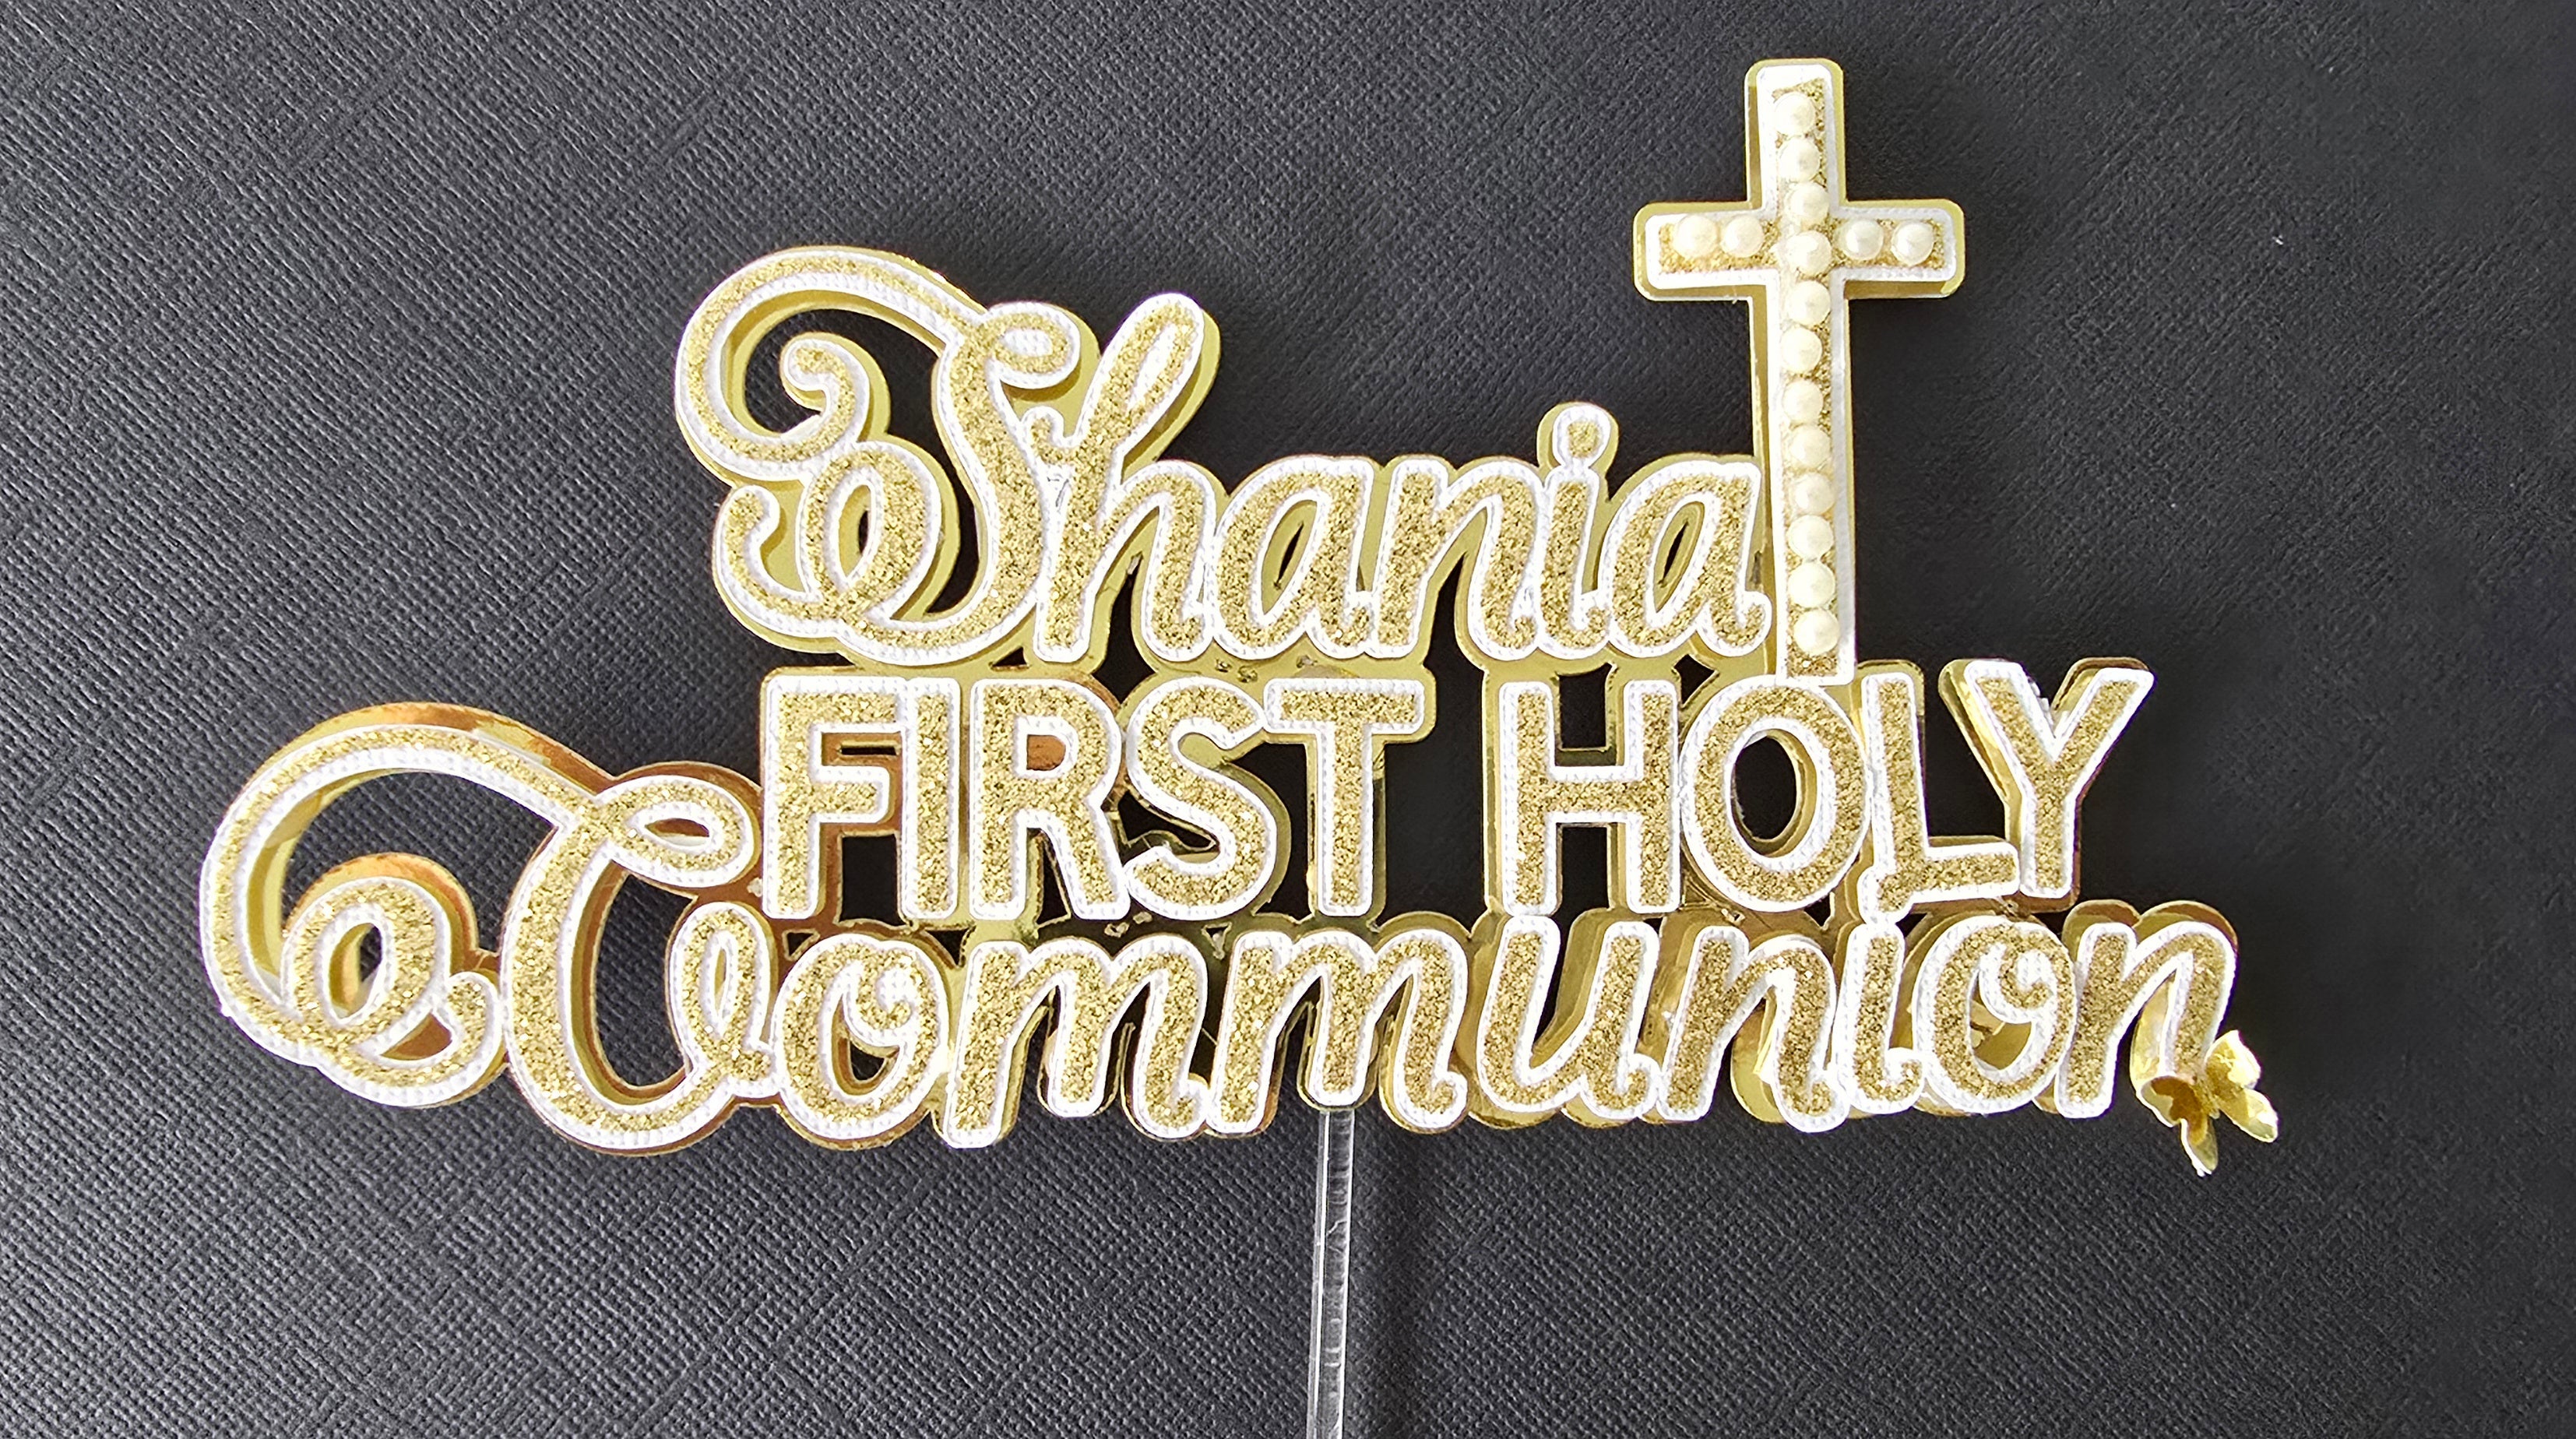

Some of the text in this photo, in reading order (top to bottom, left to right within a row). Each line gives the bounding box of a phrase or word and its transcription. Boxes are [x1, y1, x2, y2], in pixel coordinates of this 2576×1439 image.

[674, 246, 1774, 667] Shania
[199, 709, 2236, 1150] Communion
[760, 660, 2155, 921] FIRST HOLY
